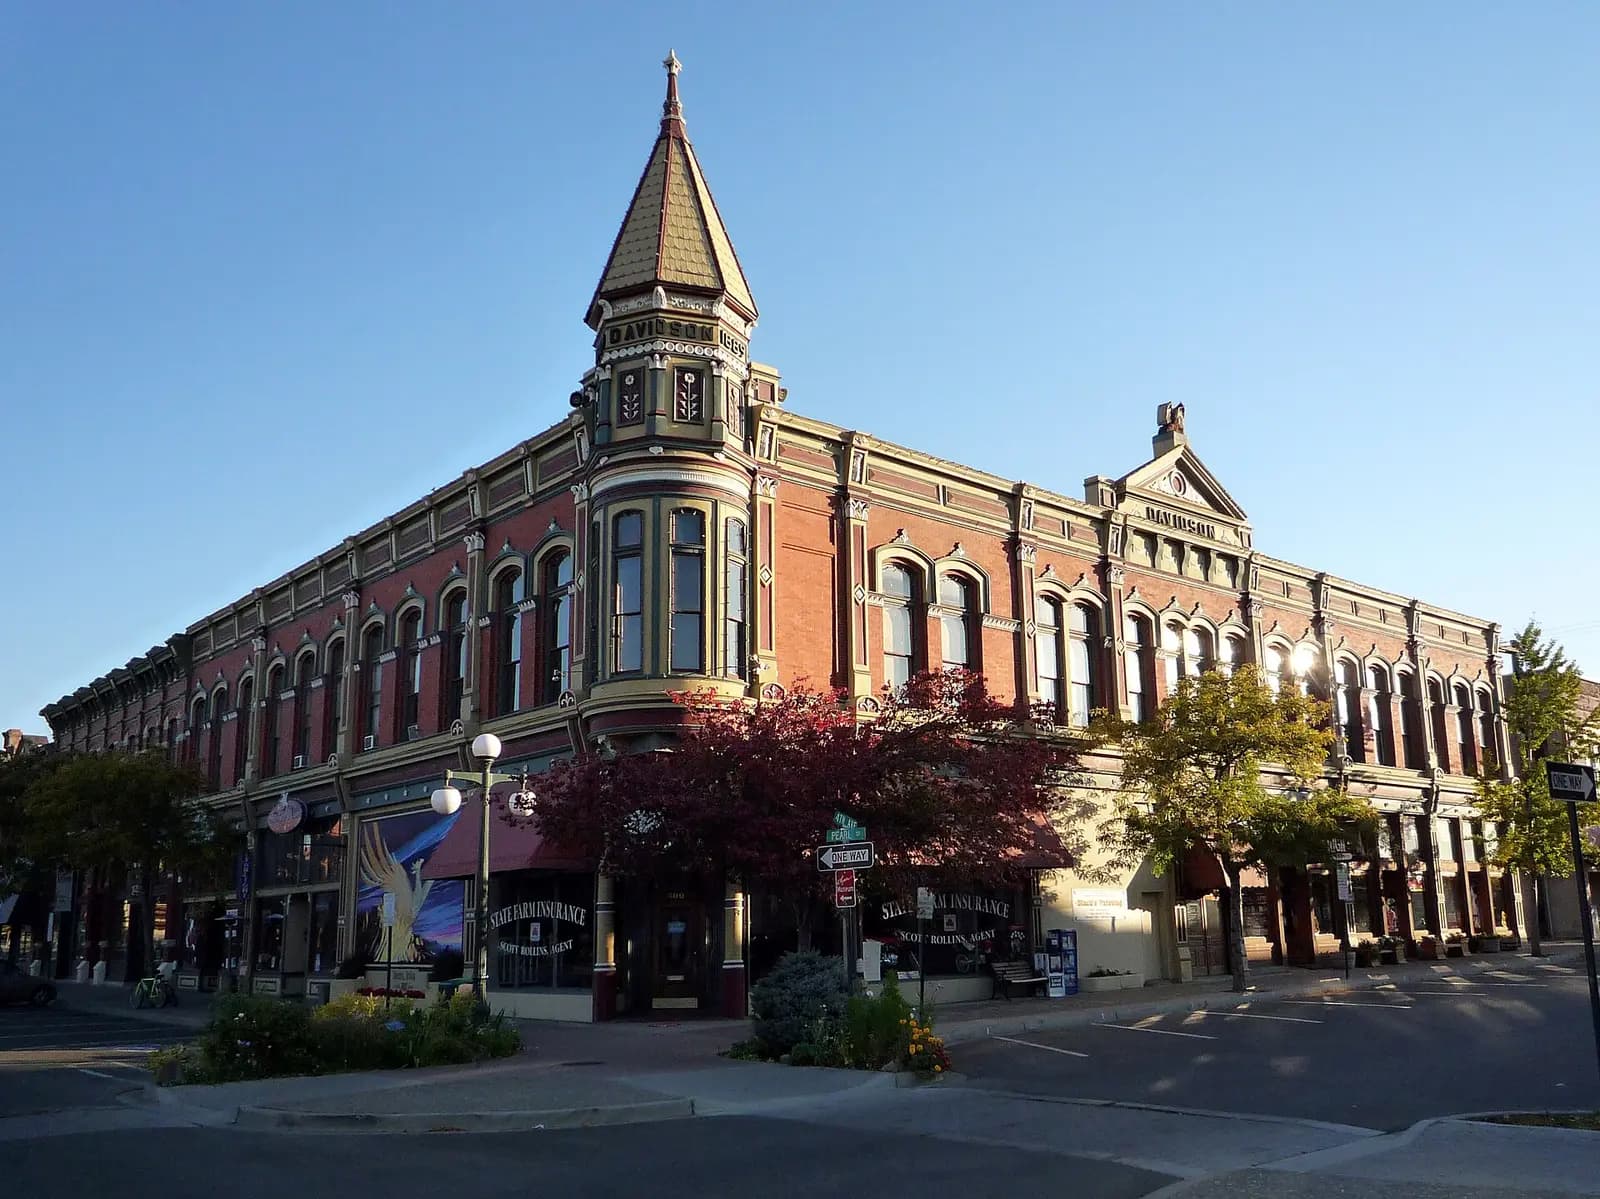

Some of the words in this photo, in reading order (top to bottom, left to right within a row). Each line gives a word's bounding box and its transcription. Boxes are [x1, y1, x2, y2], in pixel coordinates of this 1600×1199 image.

[609, 318, 714, 345] DAVIDSON
[719, 329, 746, 358] 1889
[1145, 506, 1216, 539] DAVIDSON
[1552, 773, 1567, 788] ONE
[1568, 775, 1583, 790] WAY
[832, 852, 848, 863] ONE
[849, 850, 867, 862] WAY
[490, 905, 513, 930] STATE
[513, 901, 536, 921] FARM
[536, 901, 587, 926] INSURANCE
[949, 893, 1010, 919] INSURANCE
[551, 938, 574, 954] AGENT
[970, 929, 997, 944] AGENT
